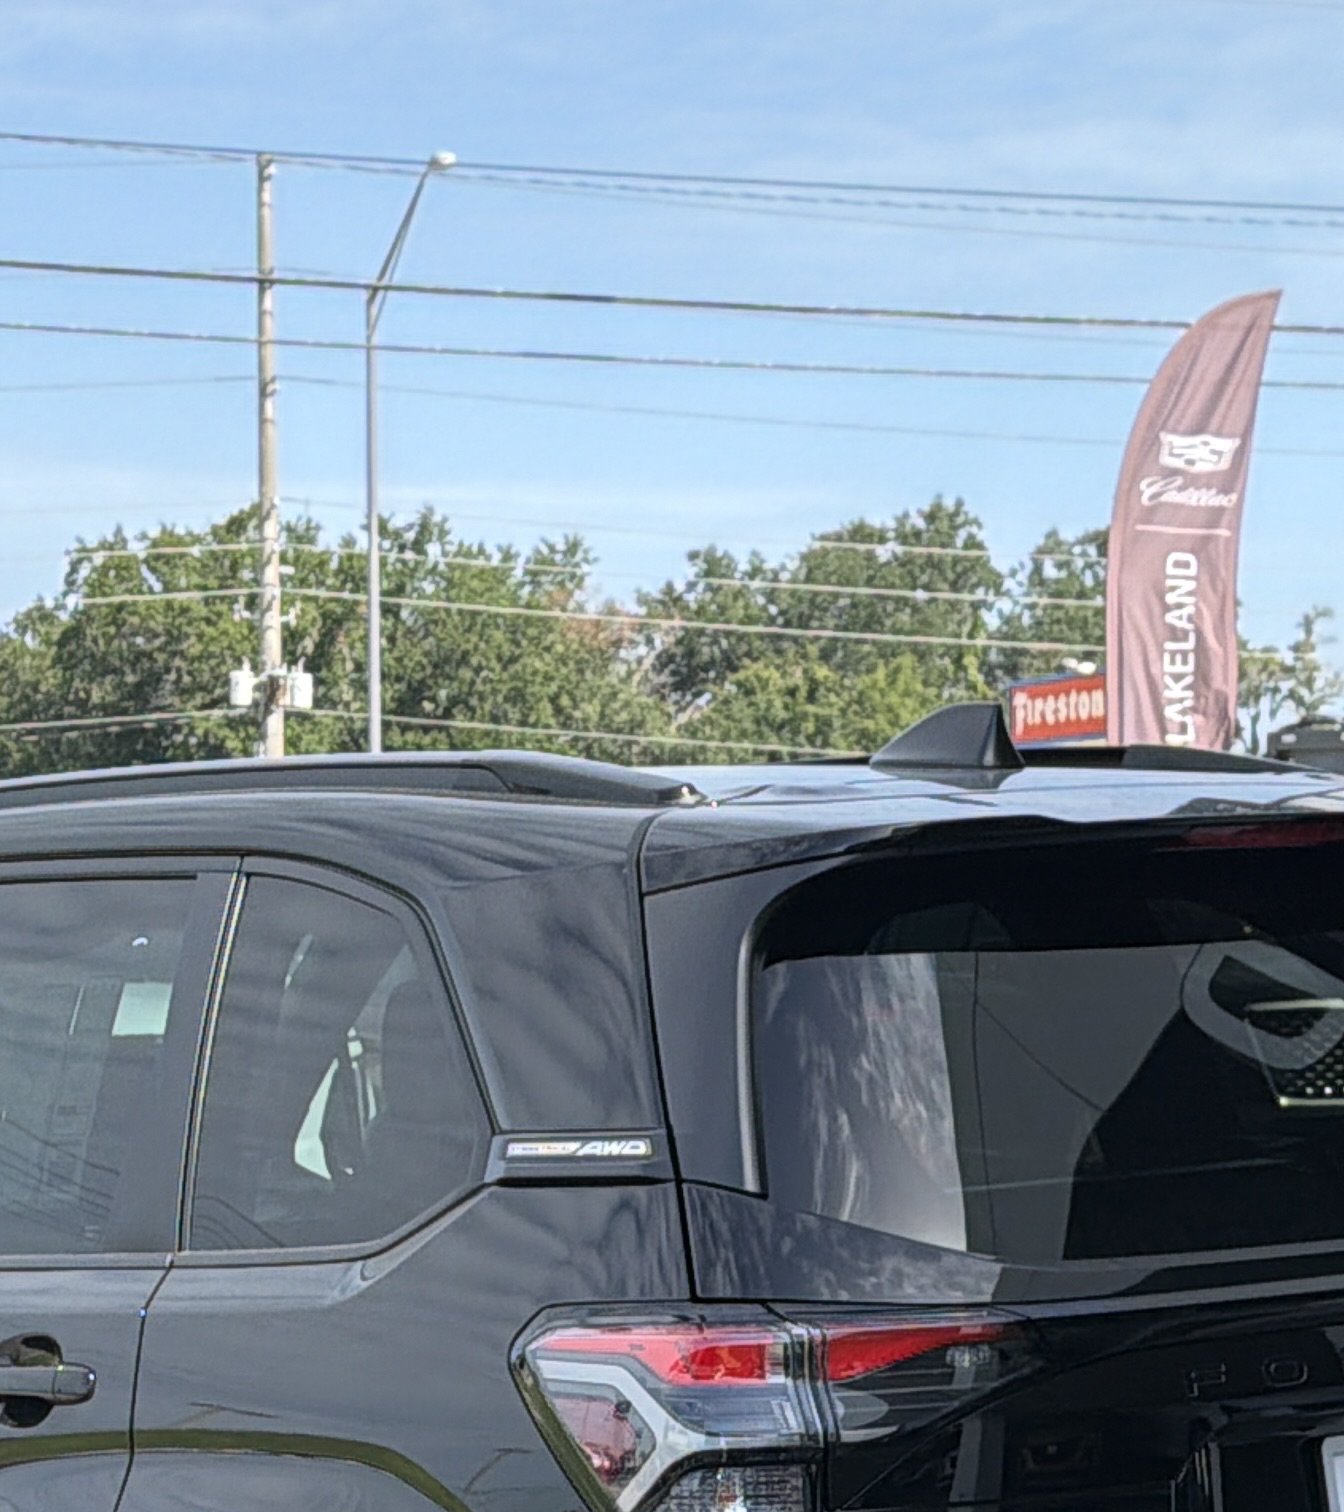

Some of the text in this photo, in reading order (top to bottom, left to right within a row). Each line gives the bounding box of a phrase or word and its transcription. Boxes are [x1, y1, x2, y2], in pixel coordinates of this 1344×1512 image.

[1139, 476, 1238, 508] Cadillac
[1163, 551, 1198, 746] LAKELAND
[1013, 689, 1105, 737] Fireston
[575, 1140, 647, 1157] AWD
